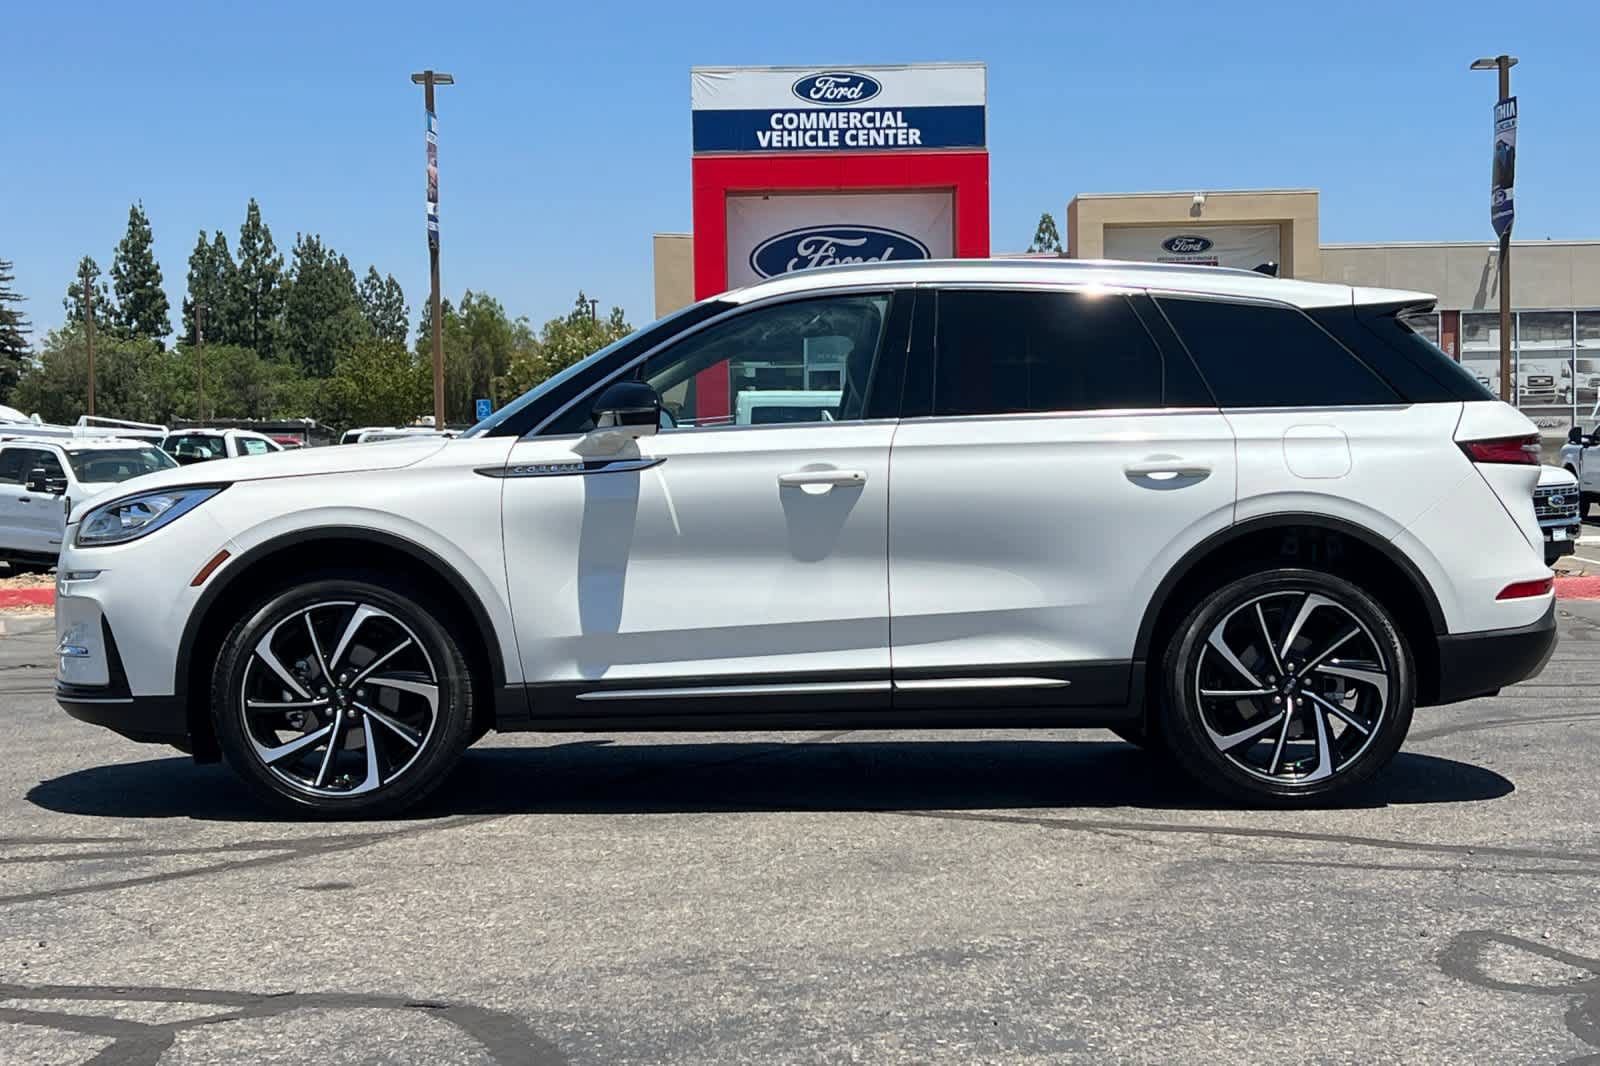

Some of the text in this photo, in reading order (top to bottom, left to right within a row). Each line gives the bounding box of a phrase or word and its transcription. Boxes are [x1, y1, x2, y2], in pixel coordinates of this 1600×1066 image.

[810, 77, 864, 99] Ford
[770, 111, 908, 130] COMMERCIAL
[757, 128, 922, 148] VEHICLE CENTER
[1171, 238, 1203, 251] Ford
